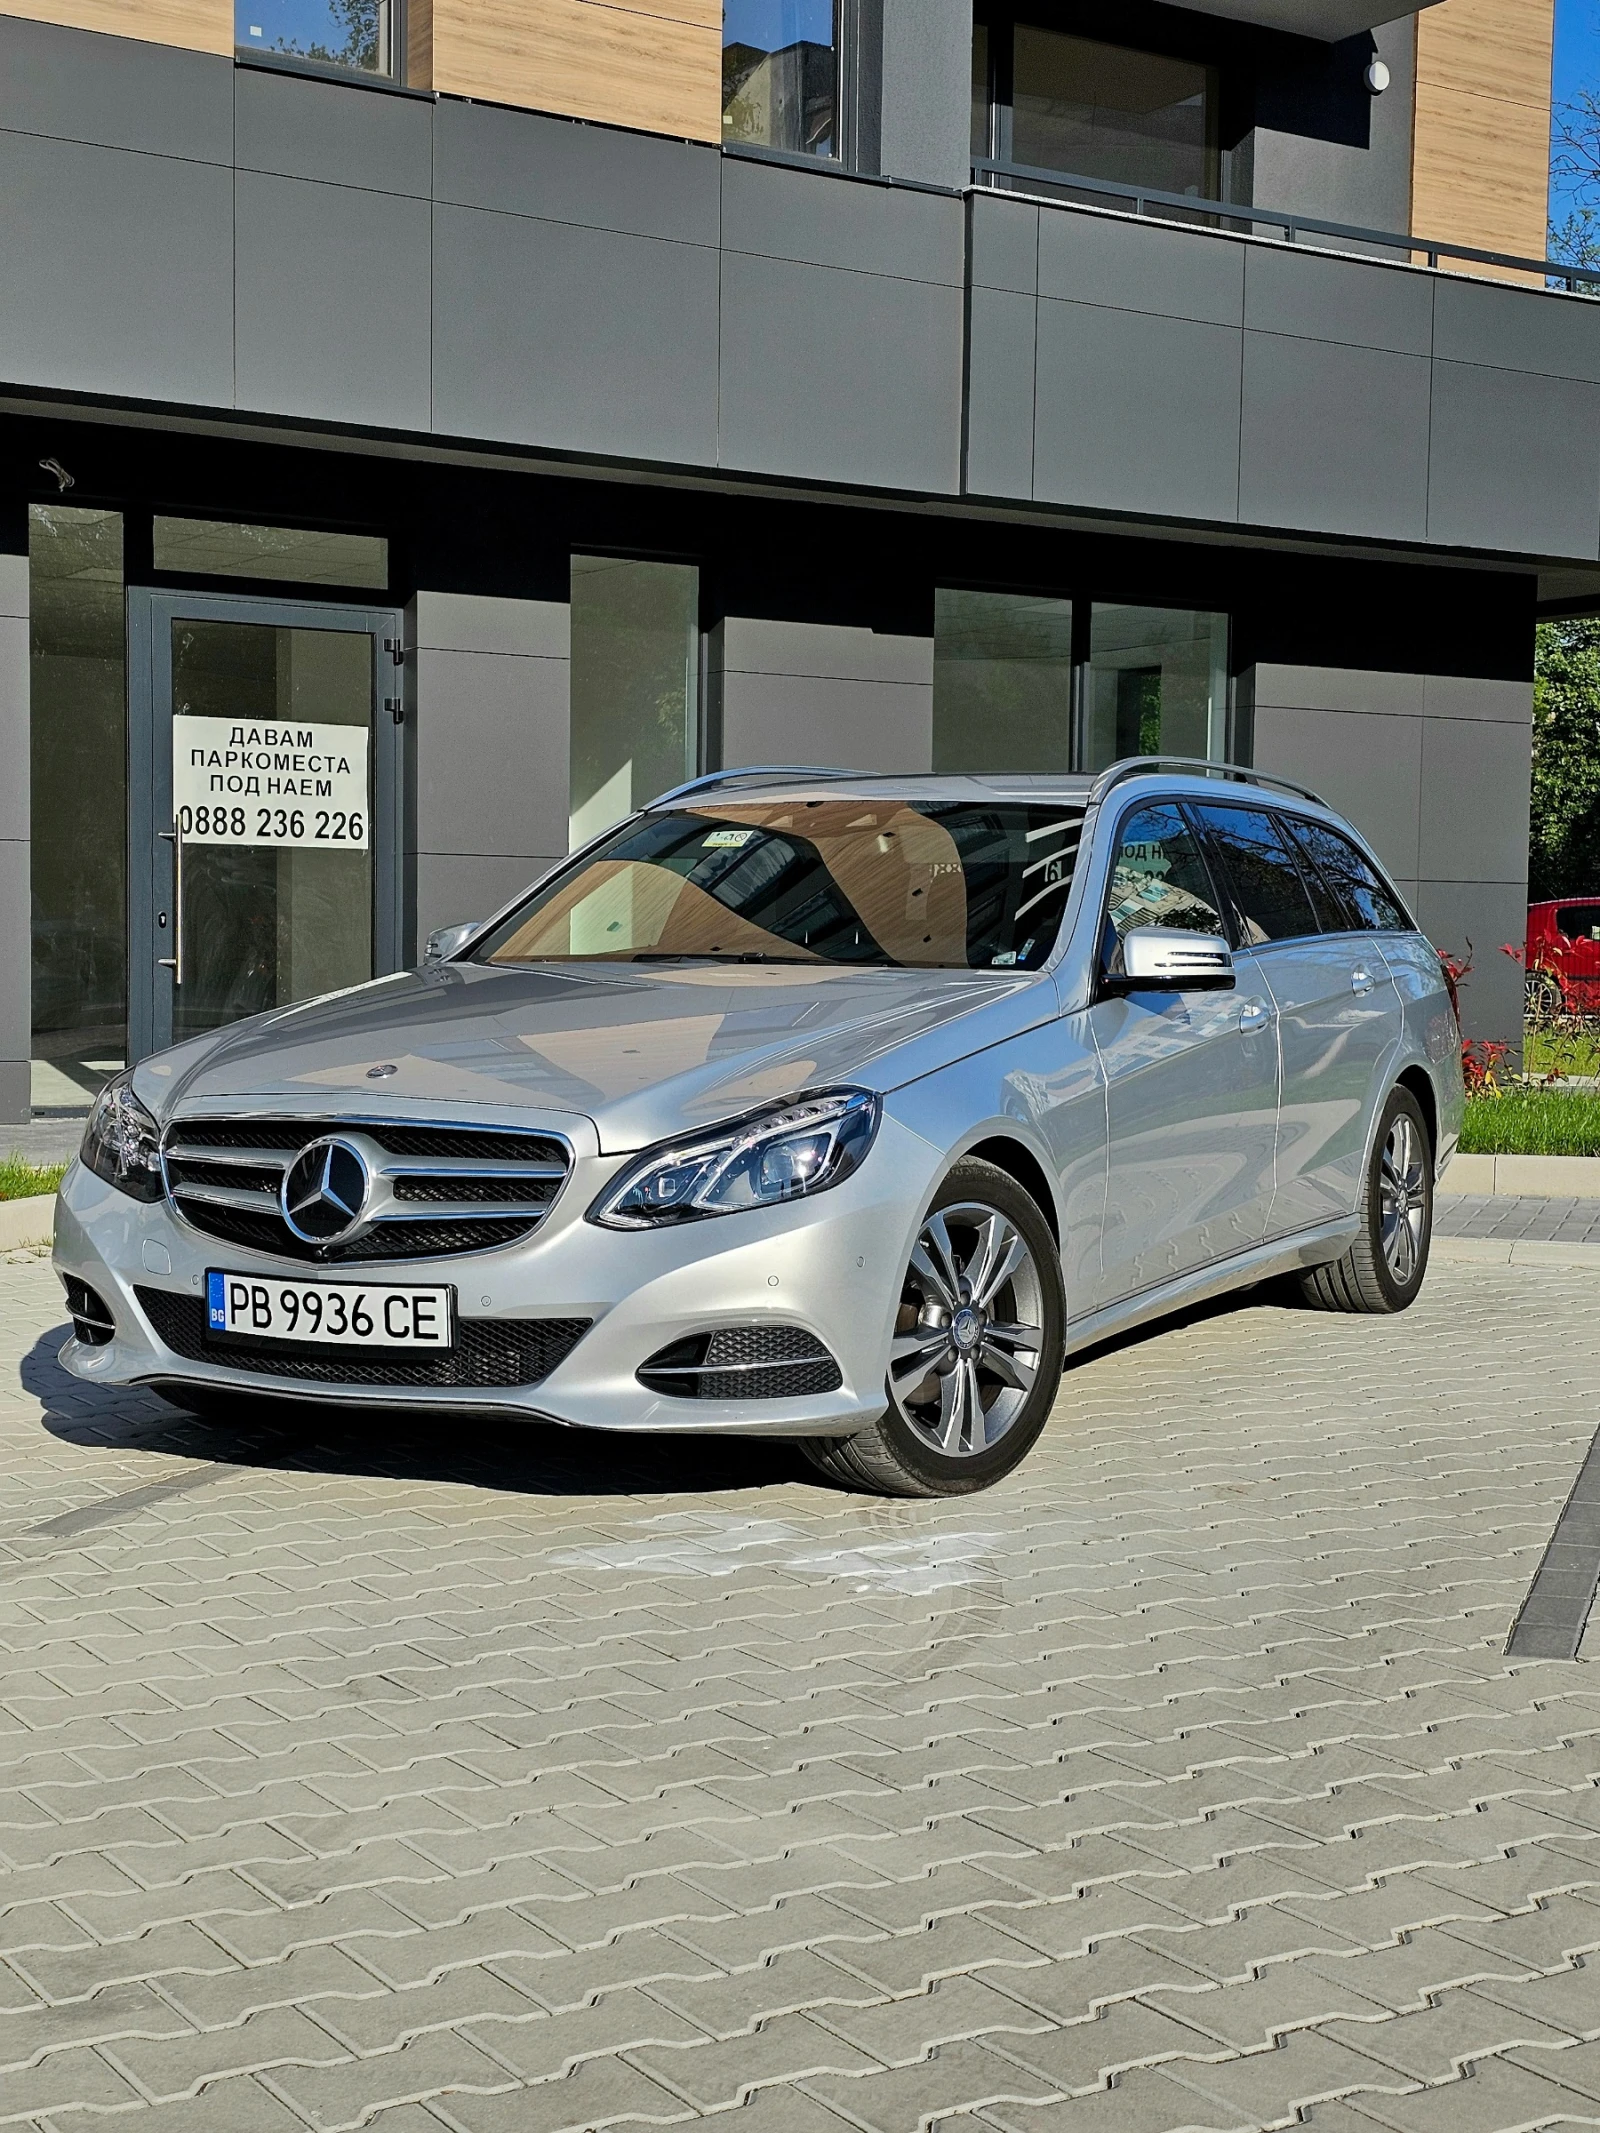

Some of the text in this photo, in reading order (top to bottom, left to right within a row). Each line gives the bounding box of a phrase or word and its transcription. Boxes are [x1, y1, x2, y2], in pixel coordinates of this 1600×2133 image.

[229, 726, 313, 748] ДАВАМ
[191, 749, 350, 774] ПАРКОМЕСТА
[210, 775, 332, 797] ПОД НАЕМ
[179, 805, 364, 841] 0888 236 226
[211, 1308, 225, 1322] BG
[230, 1282, 440, 1340] PB 9936 CE
